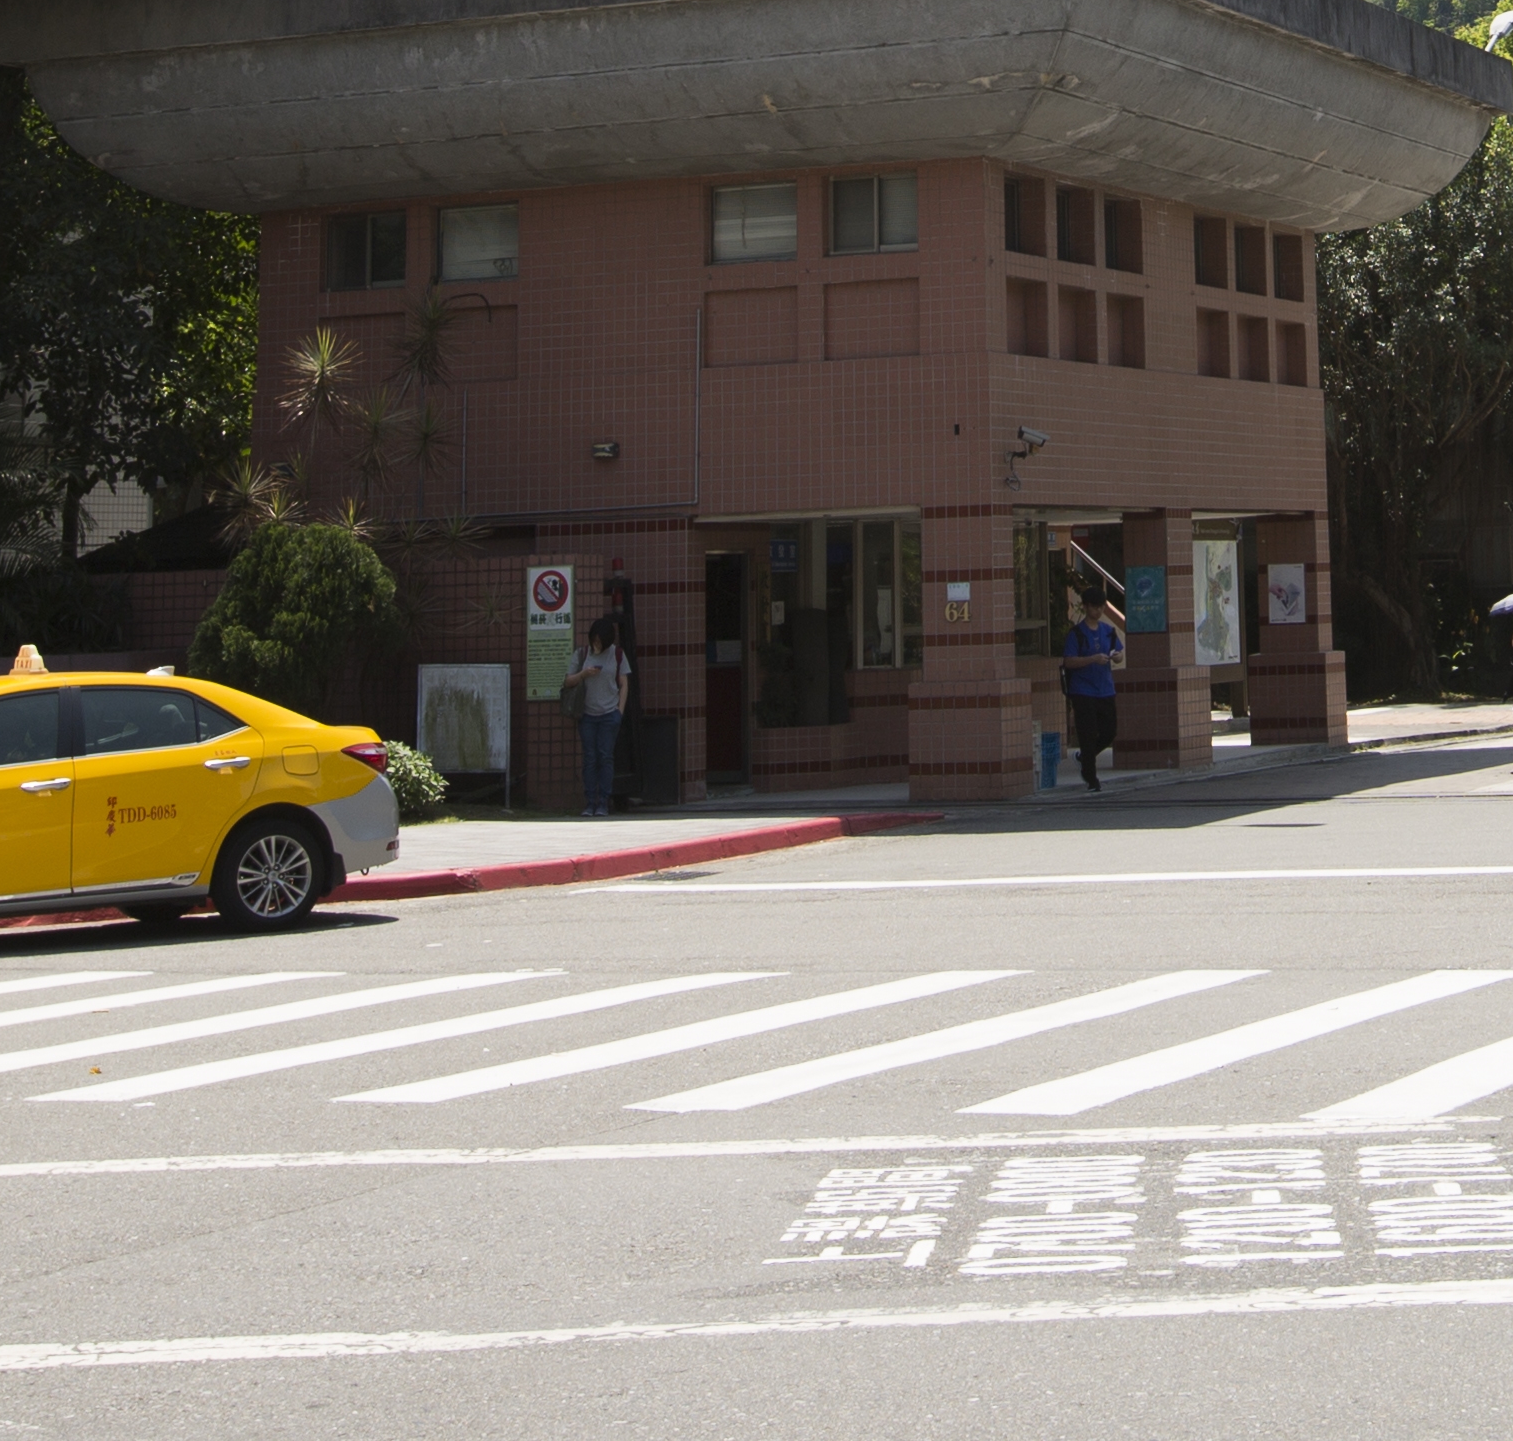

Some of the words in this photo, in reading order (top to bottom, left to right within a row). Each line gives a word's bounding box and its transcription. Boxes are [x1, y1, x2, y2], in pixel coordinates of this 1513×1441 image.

[945, 601, 971, 623] 64
[15, 660, 33, 669] TAXI
[117, 803, 177, 824] TDD-6085
